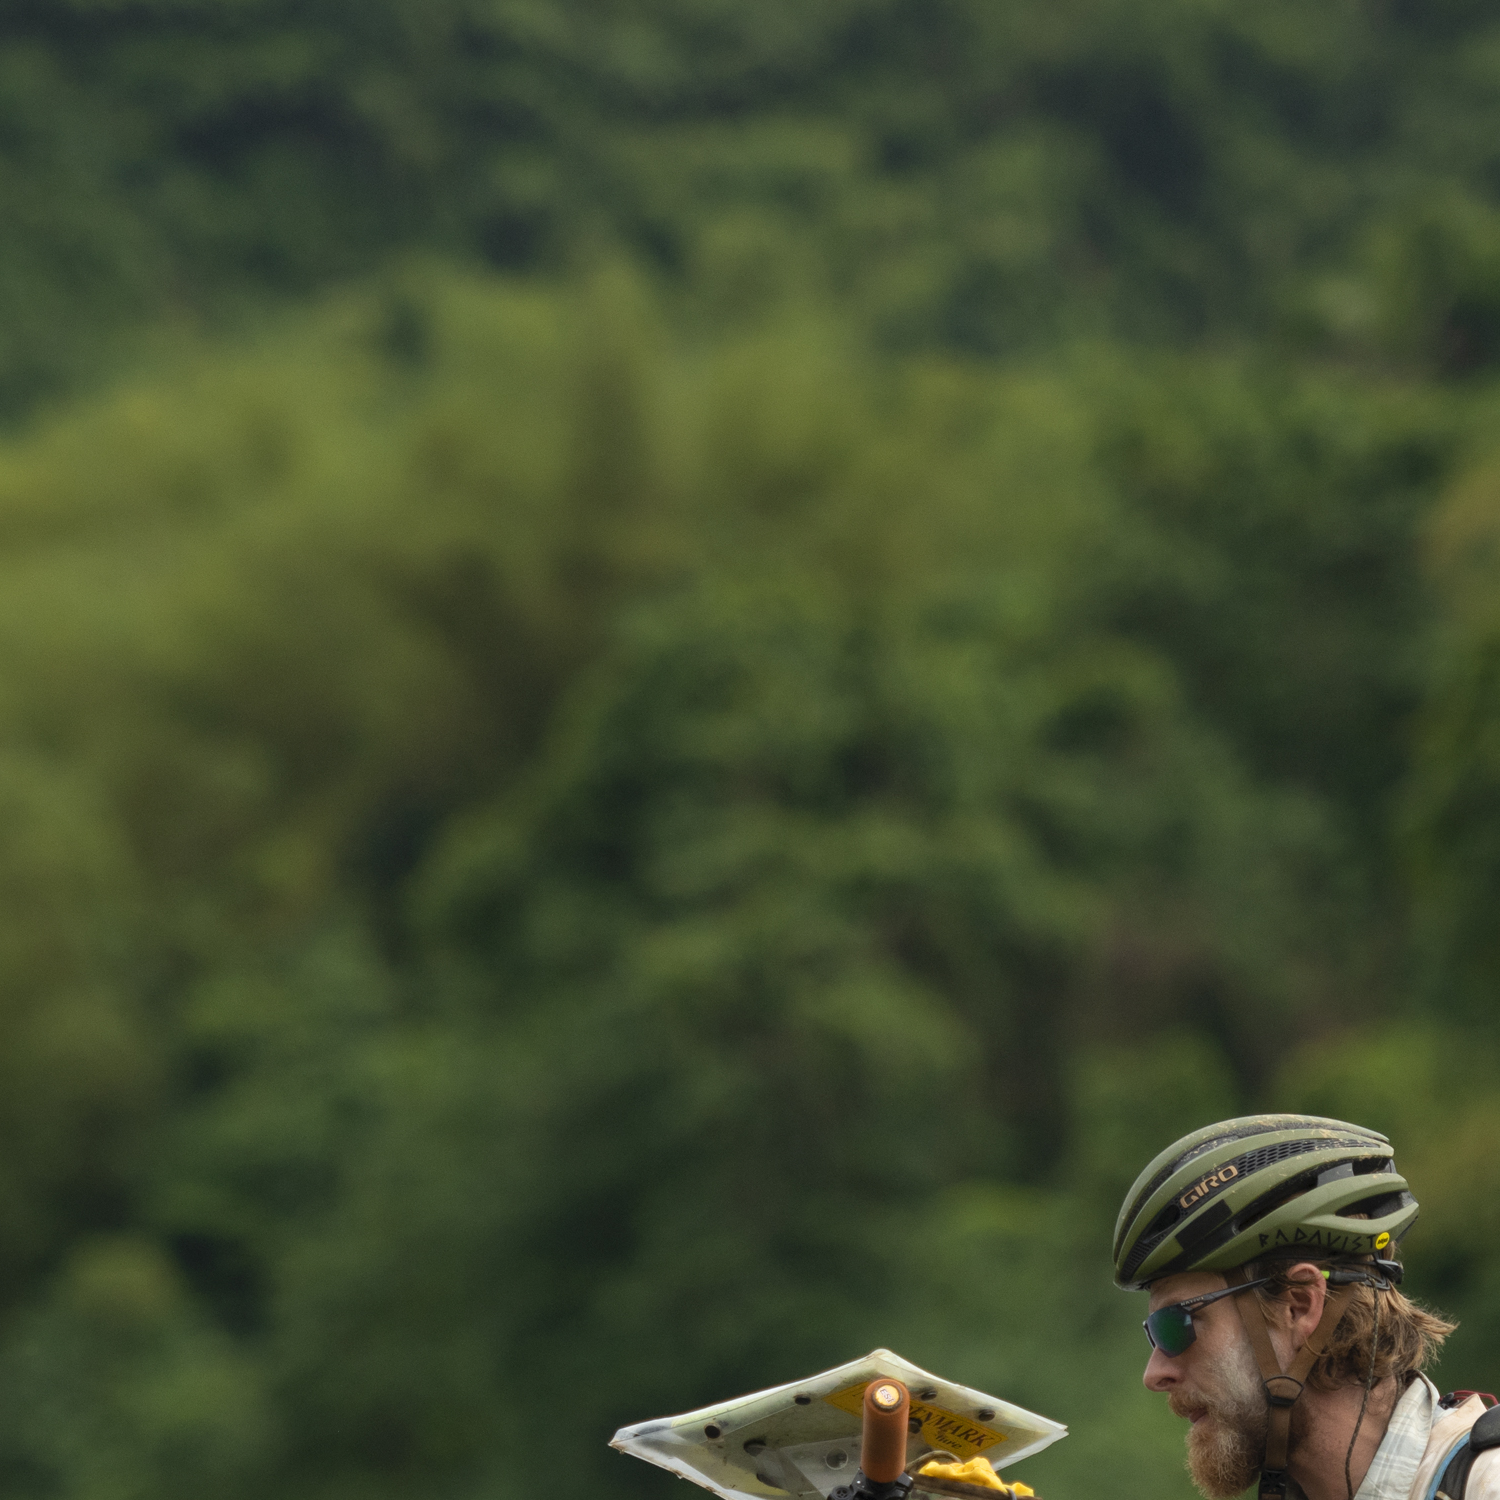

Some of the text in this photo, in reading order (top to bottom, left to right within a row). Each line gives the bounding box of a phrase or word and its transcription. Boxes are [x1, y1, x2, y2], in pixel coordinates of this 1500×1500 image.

[1180, 1165, 1238, 1209] GIRO
[1258, 1227, 1376, 1251] RADAVIST
[910, 1404, 996, 1448] ENMARK
